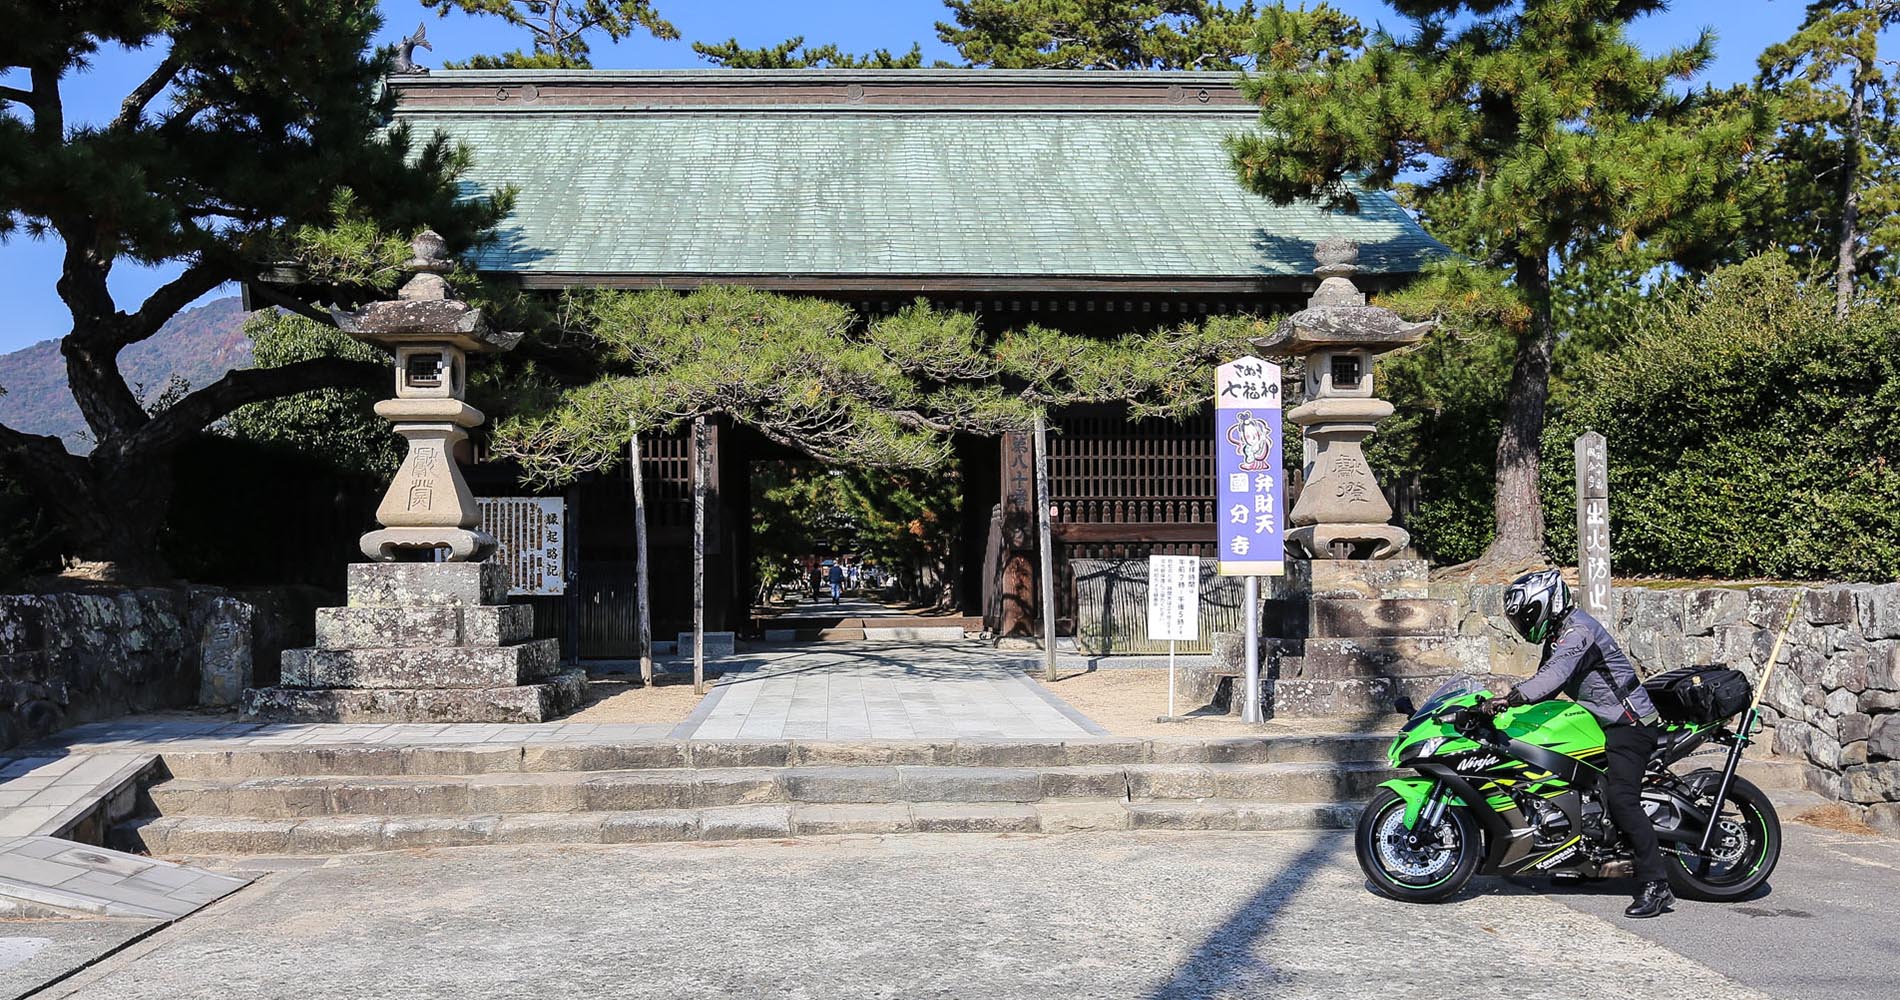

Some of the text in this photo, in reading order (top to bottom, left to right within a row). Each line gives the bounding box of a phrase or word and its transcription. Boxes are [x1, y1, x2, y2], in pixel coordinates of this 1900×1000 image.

[1233, 363, 1263, 379] さぬき
[1221, 380, 1279, 400] 七福神
[1254, 473, 1274, 534] 弁財天
[1586, 501, 1608, 611] 出火防止
[1456, 753, 1500, 773] Ninja
[1535, 845, 1577, 870] Kawasaki
